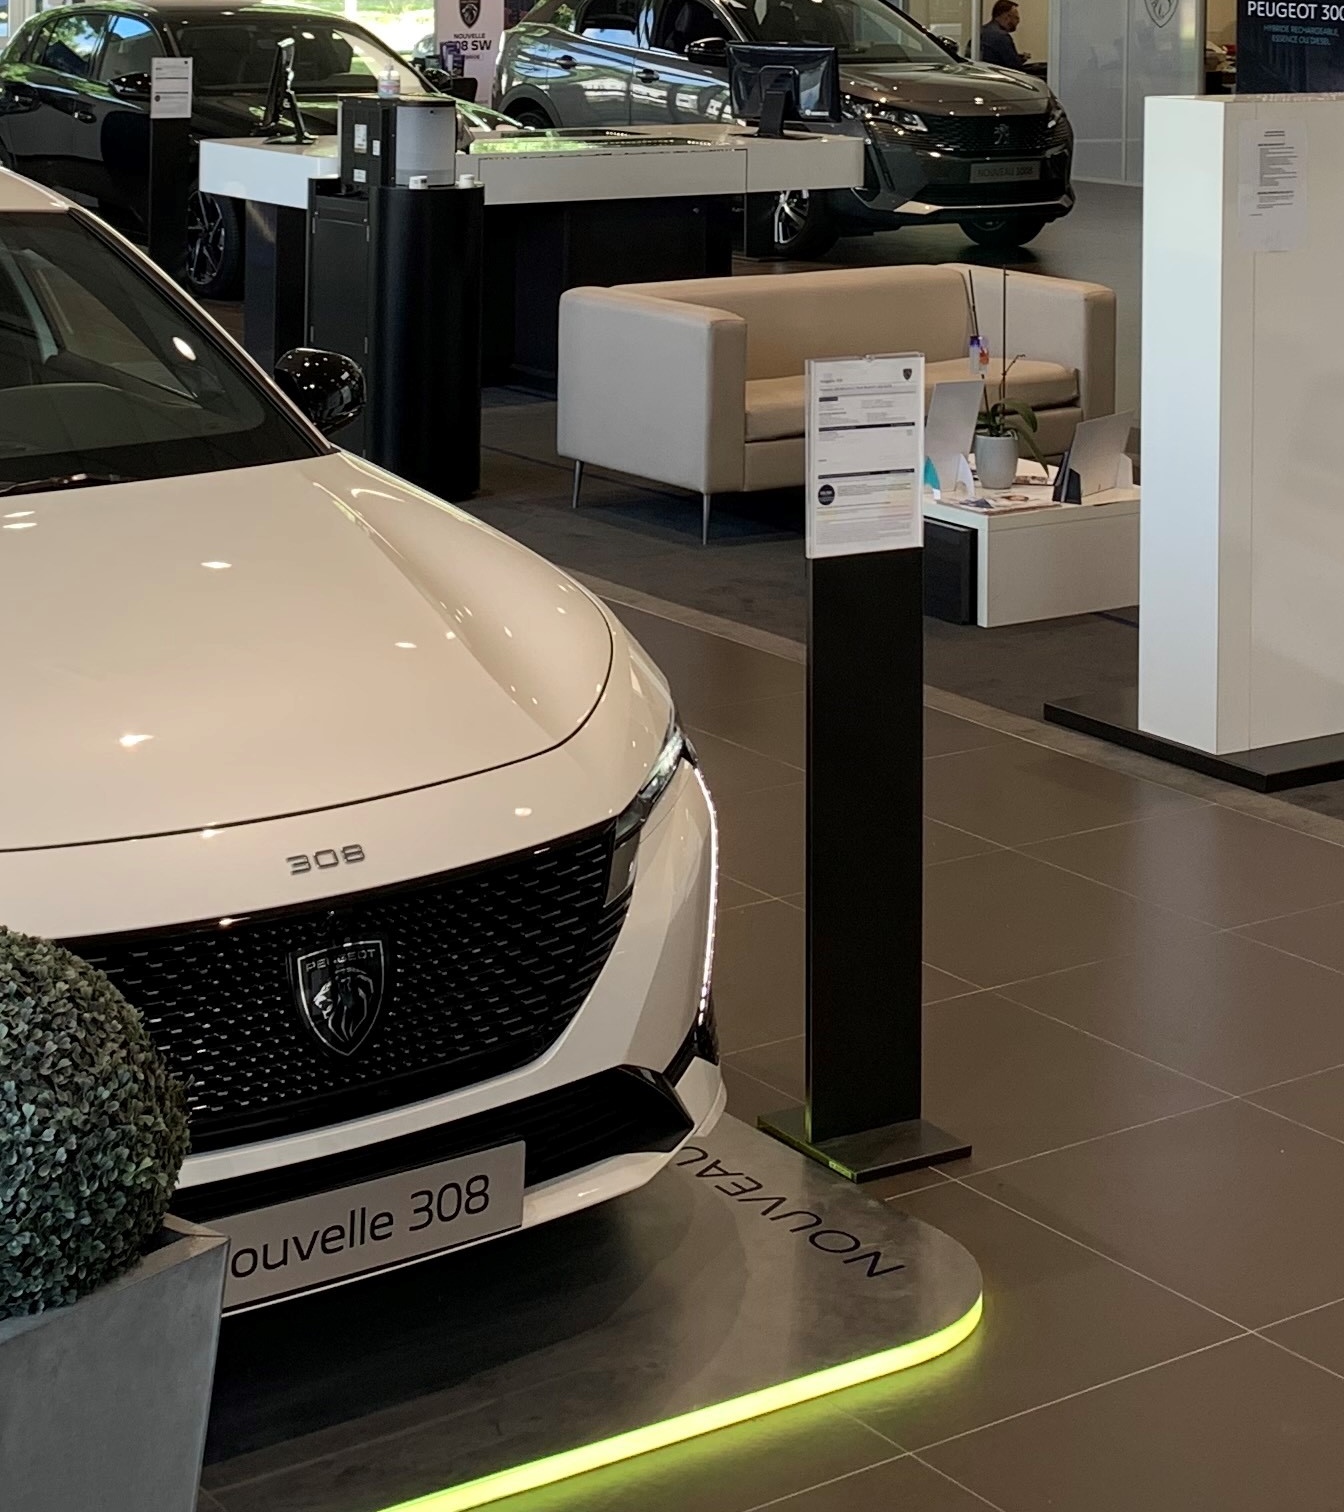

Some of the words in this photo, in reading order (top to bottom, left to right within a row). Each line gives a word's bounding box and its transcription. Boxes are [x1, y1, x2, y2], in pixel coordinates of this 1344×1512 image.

[1247, 1, 1318, 20] PEUGEOT
[471, 39, 492, 51] SW
[286, 844, 365, 876] 308
[230, 1207, 395, 1279] ouvelle
[409, 1174, 491, 1232] 308
